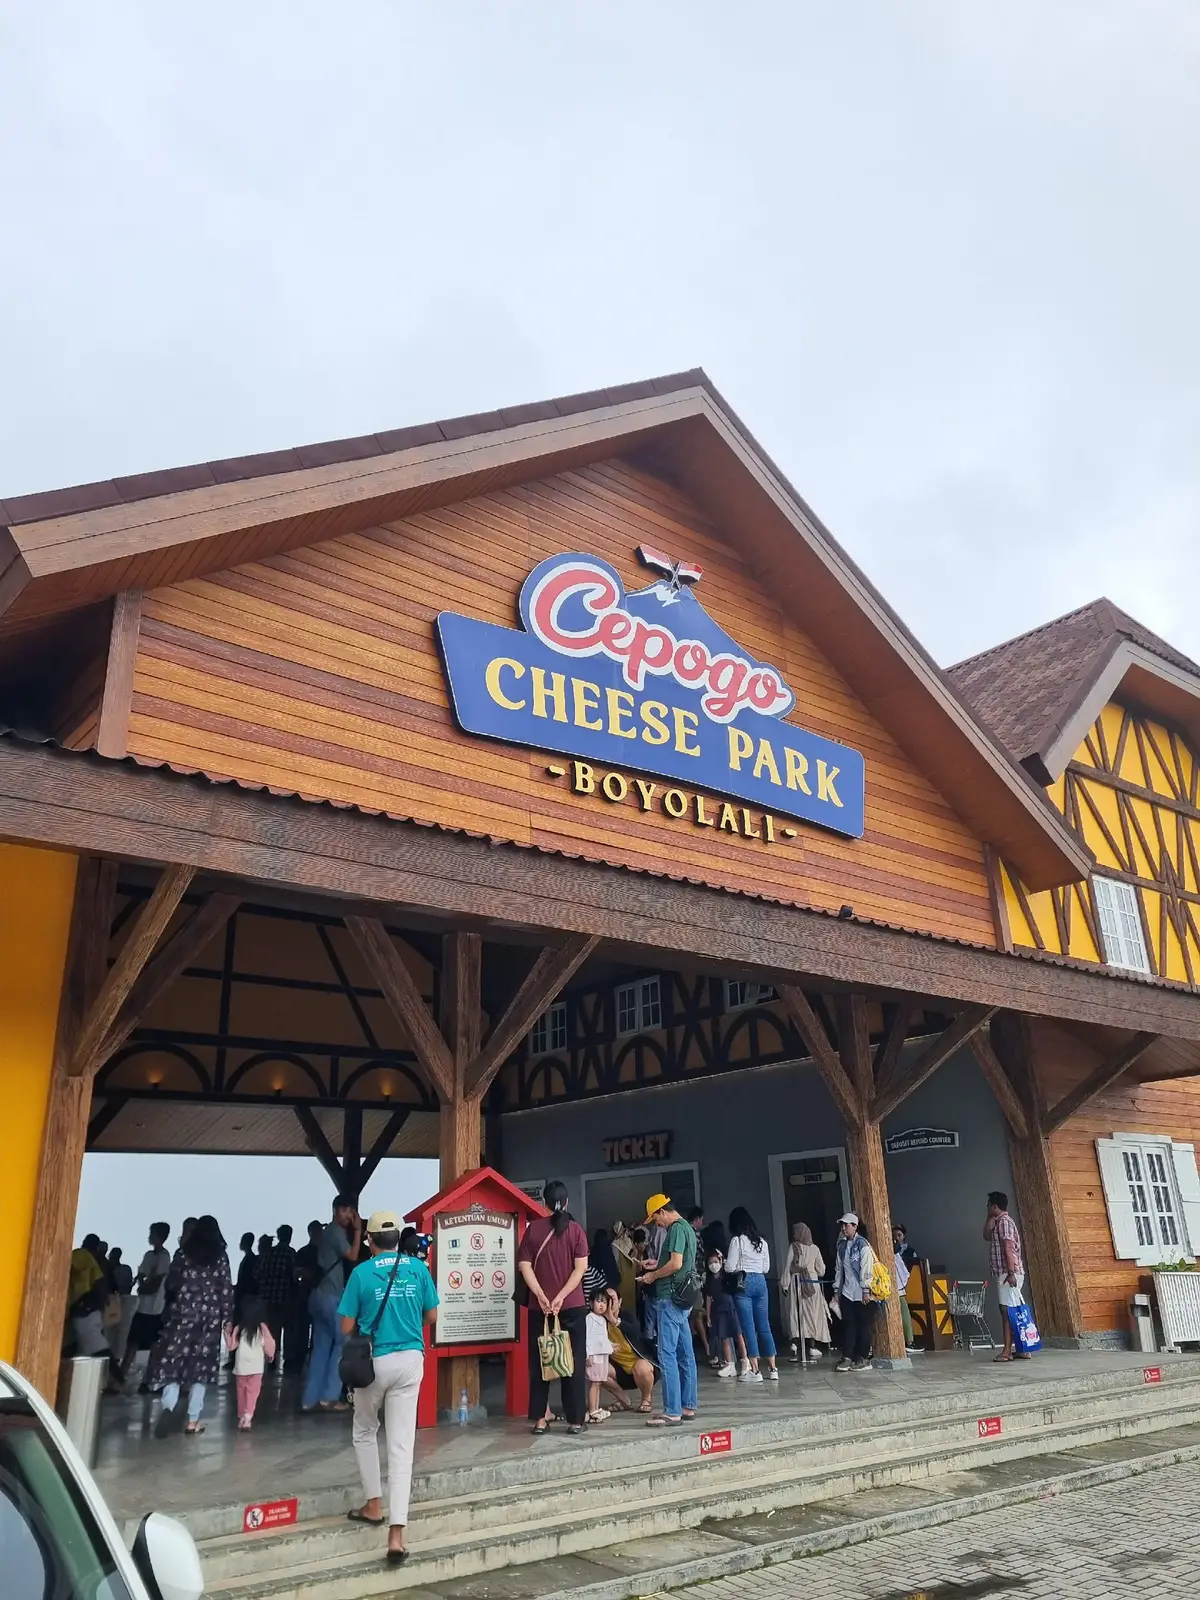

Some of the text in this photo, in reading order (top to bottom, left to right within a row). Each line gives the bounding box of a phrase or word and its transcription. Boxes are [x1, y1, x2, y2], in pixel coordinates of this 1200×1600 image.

[533, 566, 789, 719] Cepogo
[485, 657, 844, 808] CHEESE PARK
[602, 1132, 669, 1165] TICKET
[444, 1214, 508, 1227] KETENTUAN UMUM
